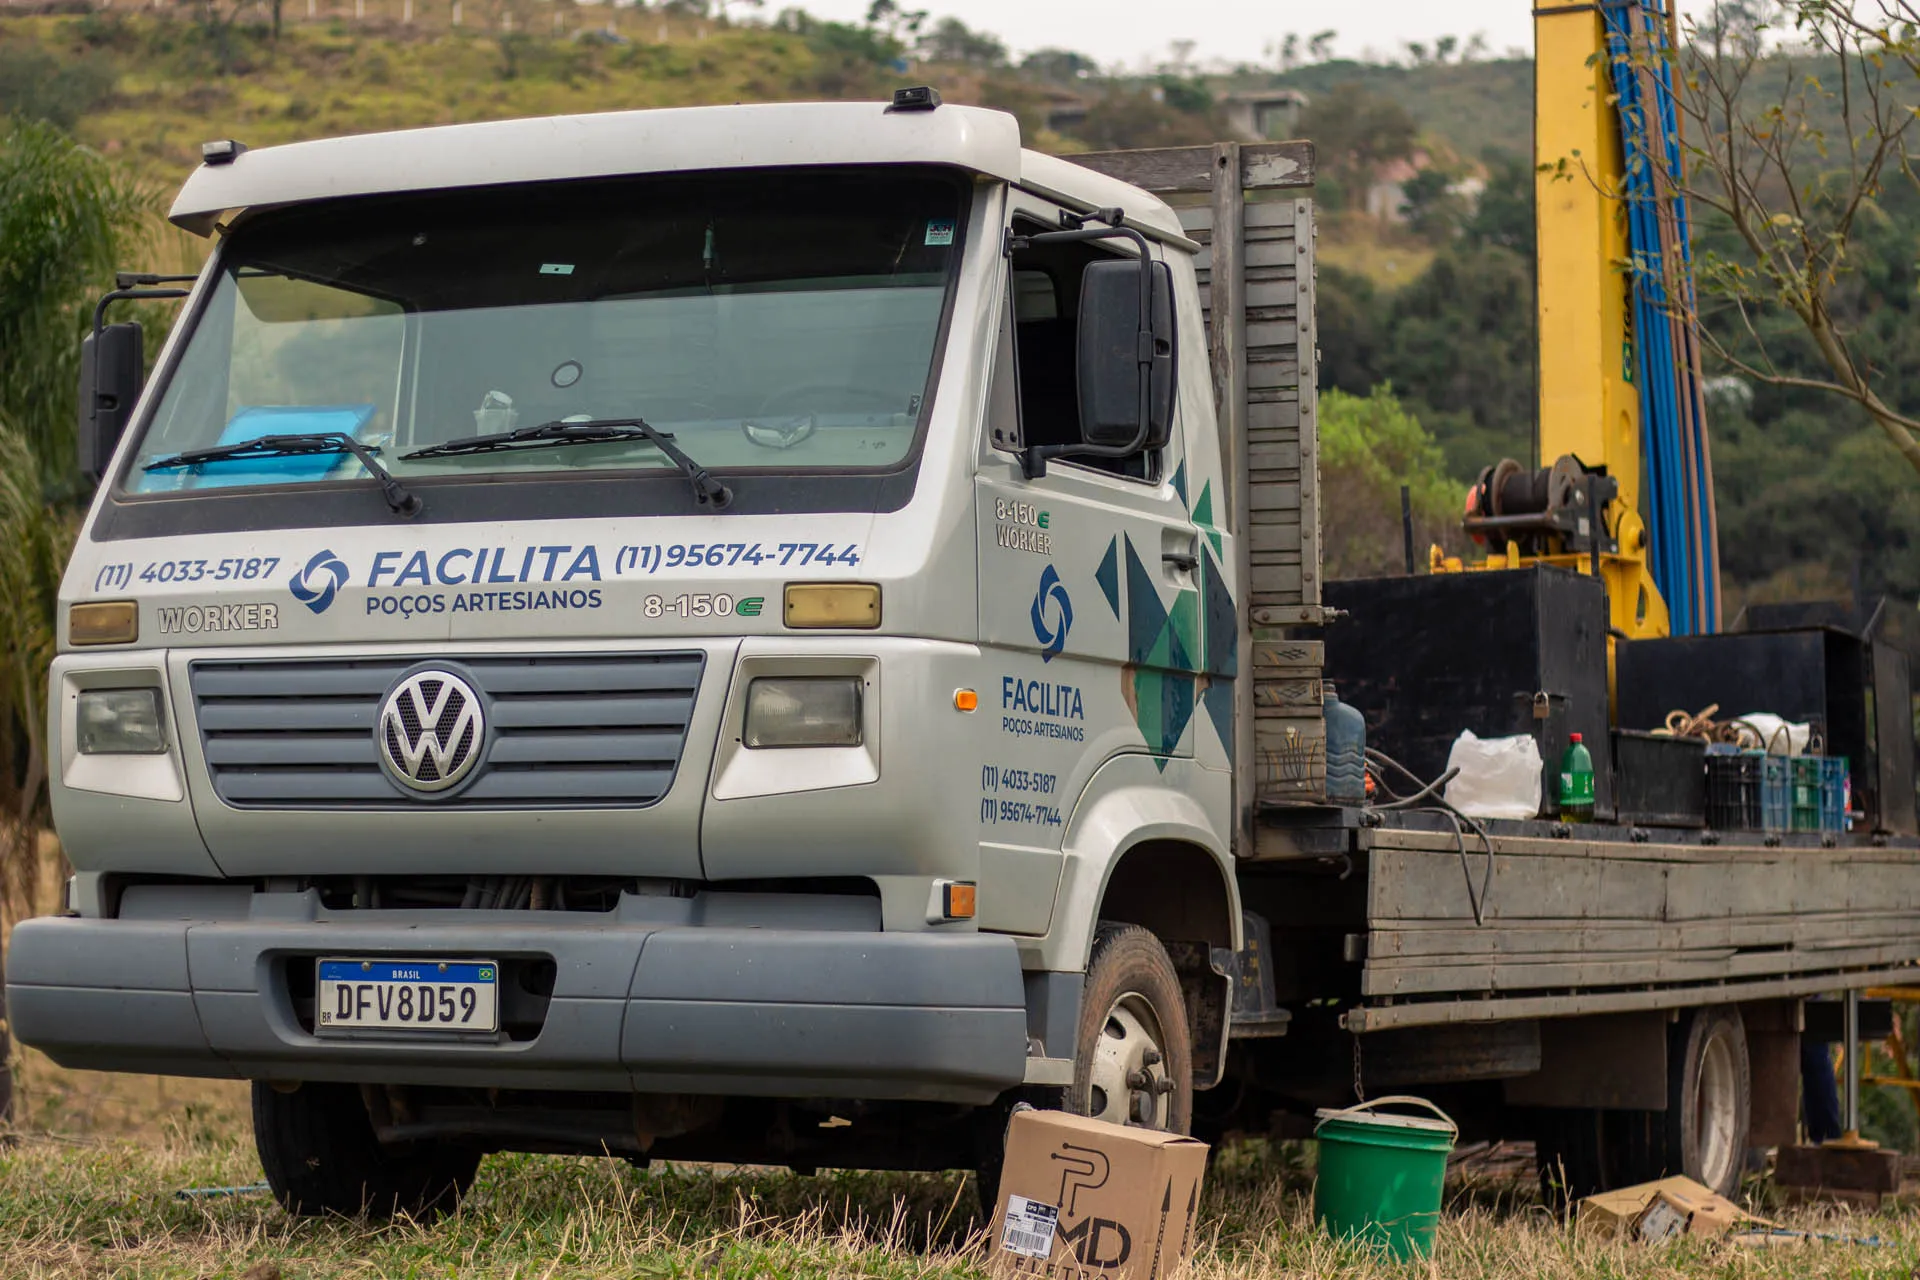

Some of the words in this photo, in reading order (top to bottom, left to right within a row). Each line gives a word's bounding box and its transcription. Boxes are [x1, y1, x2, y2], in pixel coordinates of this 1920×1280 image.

[996, 524, 1052, 556] WORKER
[95, 562, 133, 592] (11)
[139, 557, 281, 583] 4033-5187
[367, 545, 602, 588] FACILITA
[157, 603, 279, 634] WORKER
[366, 594, 446, 619] POÇOS
[451, 589, 602, 612] ARTESIANOS
[1002, 676, 1084, 720] FACILITA
[1002, 716, 1032, 738] POÇOS
[1034, 721, 1084, 742] ARTESIANOS
[982, 765, 999, 792] (11)
[1001, 769, 1056, 794] 4033-5187
[1000, 801, 1062, 827] 95674-7744
[392, 970, 420, 979] BRASIL
[322, 1012, 332, 1023] BR
[335, 984, 477, 1023] DFV8D59
